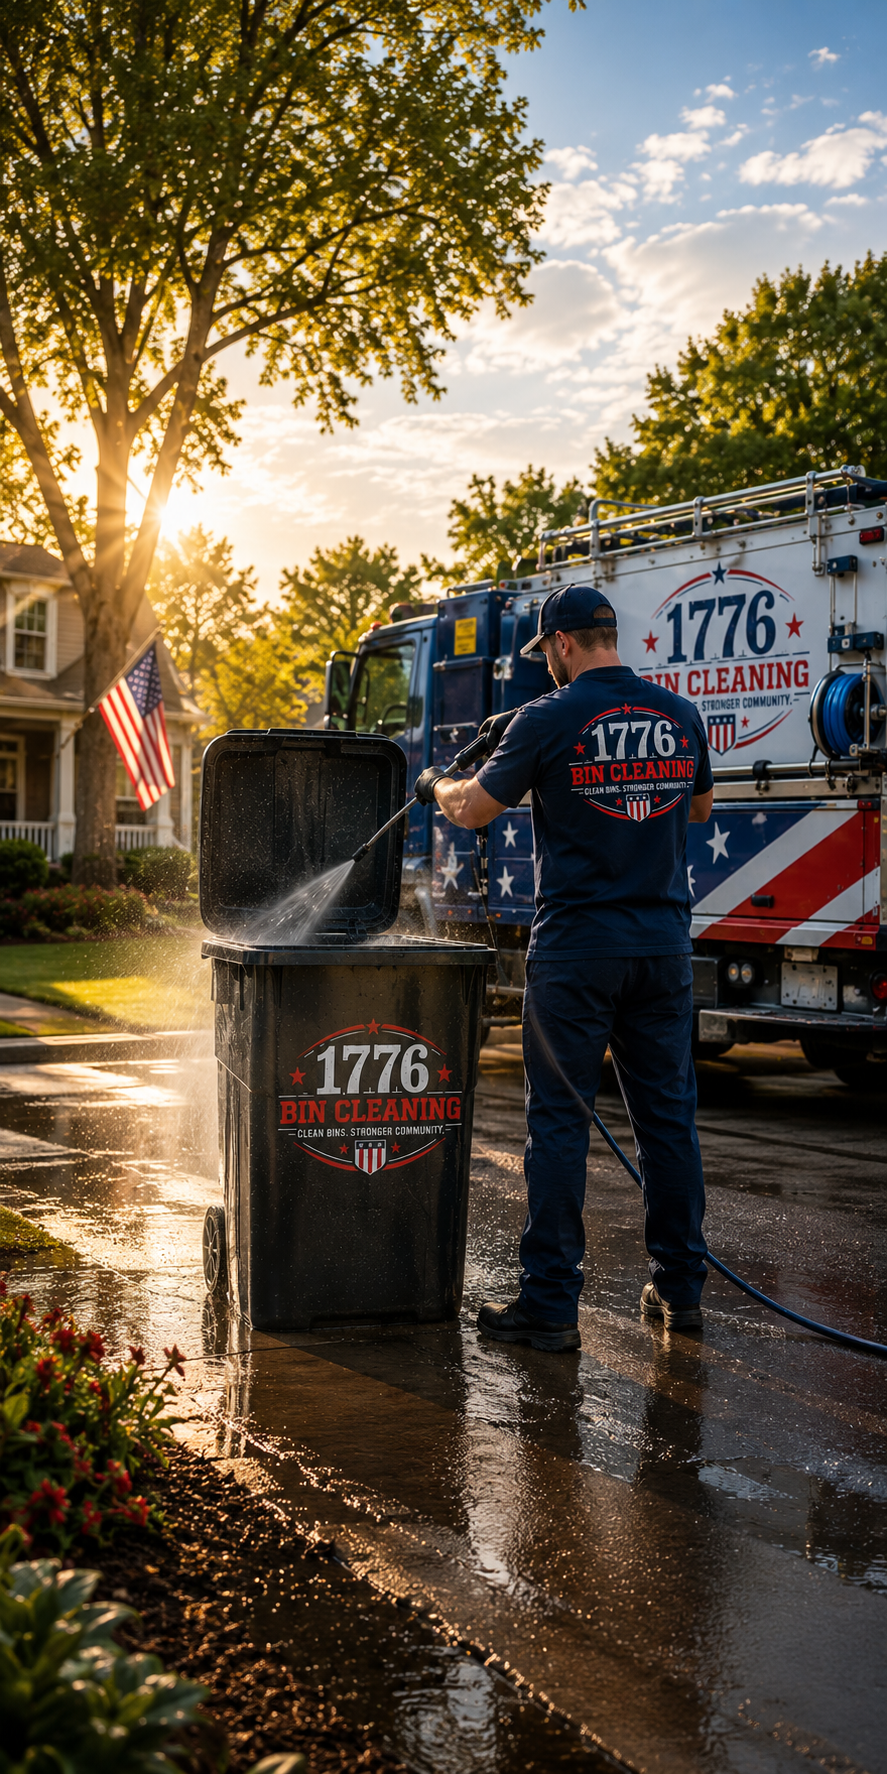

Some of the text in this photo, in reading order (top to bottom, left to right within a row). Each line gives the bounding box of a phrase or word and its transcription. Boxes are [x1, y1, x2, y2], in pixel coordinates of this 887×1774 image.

[666, 590, 776, 664] 1776
[687, 660, 809, 696] CLEANING
[702, 697, 740, 712] STRONGER
[742, 694, 793, 709] COMMUNITY.
[591, 720, 676, 761] 1776
[570, 760, 694, 786] BIN CLEANING
[316, 1044, 429, 1095] 1776
[280, 1097, 461, 1124] BIN CLEANING
[297, 1125, 445, 1138] CLEAN BINS. STRONGER COMMUNITY.
